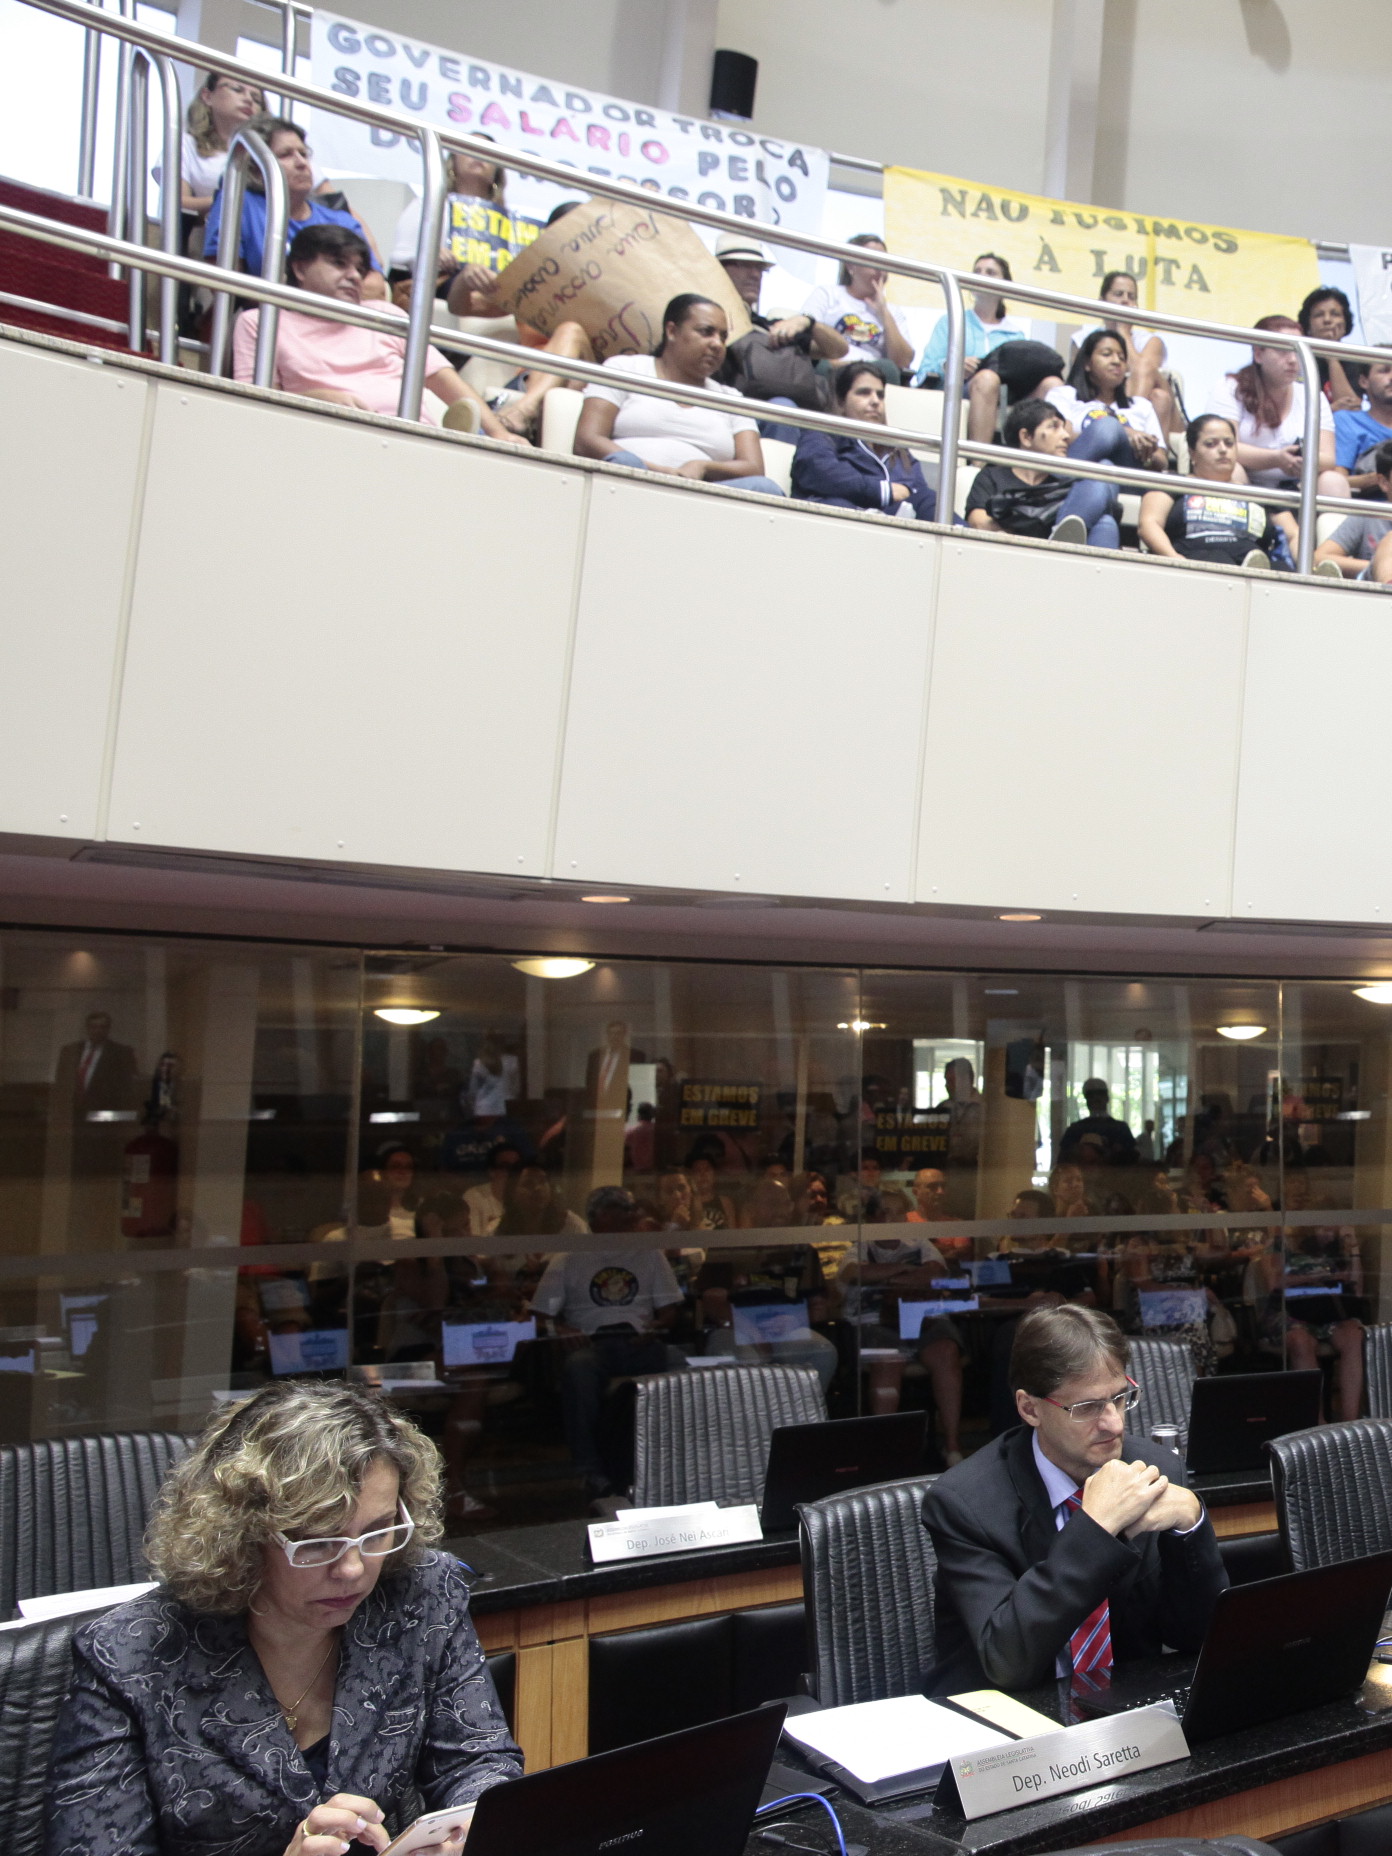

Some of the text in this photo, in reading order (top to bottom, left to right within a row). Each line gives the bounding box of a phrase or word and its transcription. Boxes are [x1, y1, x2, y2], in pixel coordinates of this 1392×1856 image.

[327, 21, 810, 178] GOVERNADOR TROCA
[331, 66, 428, 112] SEU
[698, 151, 797, 203] PELO
[1089, 248, 1212, 293] LUTA
[654, 1533, 676, 1546] José
[679, 1531, 697, 1543] Nei
[977, 1746, 1035, 1766] ASSEMBLEIA LEGISLATIVA
[1012, 1744, 1141, 1793] Dep. Neodi Saretta
